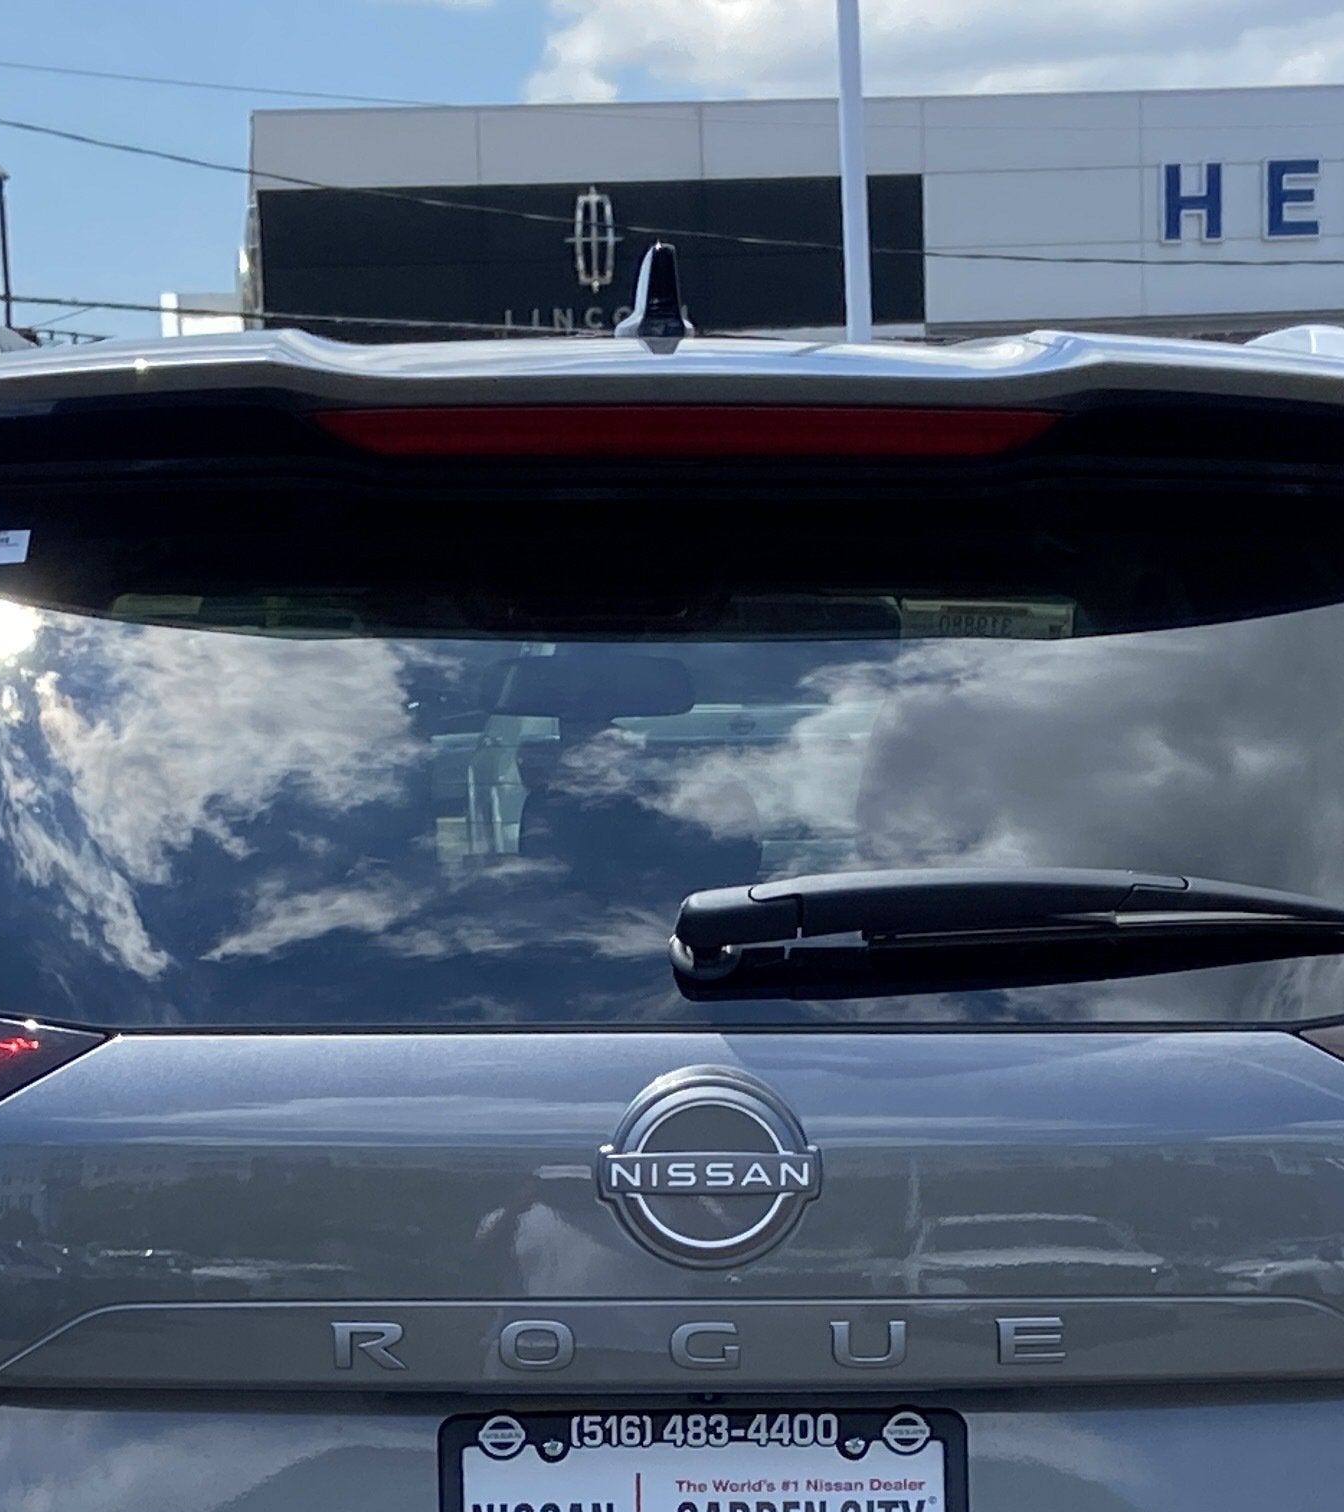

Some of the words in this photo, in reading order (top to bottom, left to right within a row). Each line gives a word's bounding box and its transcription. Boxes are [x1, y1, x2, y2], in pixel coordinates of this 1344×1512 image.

[505, 303, 689, 330] LINCO
[611, 1162, 809, 1187] NISSAN
[330, 1317, 1068, 1371] ROGUE
[570, 1414, 653, 1447] (516)
[662, 1413, 838, 1446] 483-4400
[675, 1480, 707, 1493] The
[712, 1479, 776, 1492] World's
[781, 1479, 799, 1492] #1
[806, 1479, 864, 1492] Nissan
[869, 1478, 926, 1491] Dealer
